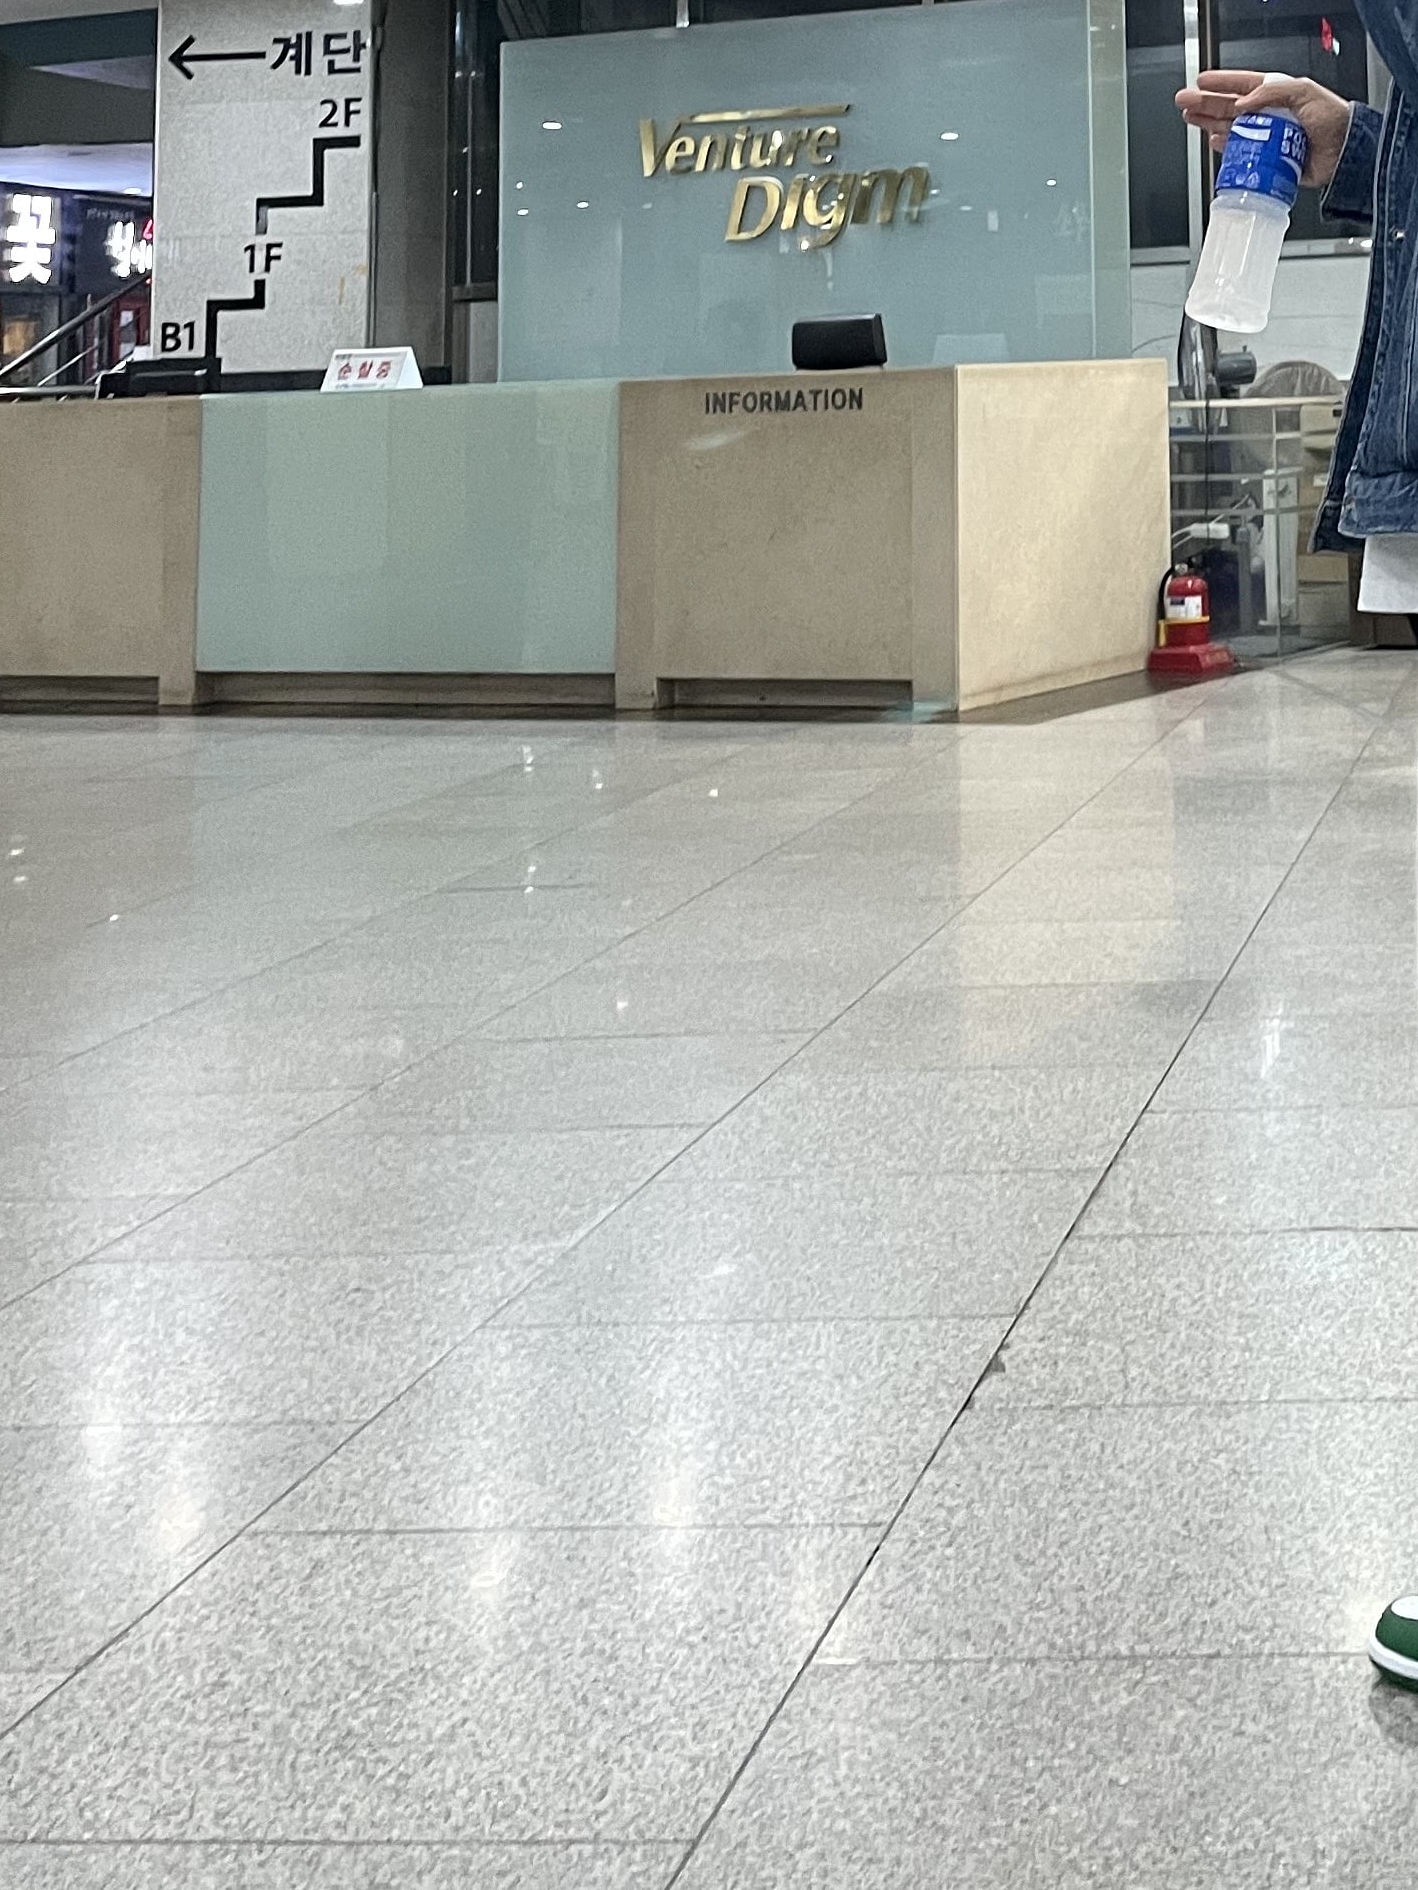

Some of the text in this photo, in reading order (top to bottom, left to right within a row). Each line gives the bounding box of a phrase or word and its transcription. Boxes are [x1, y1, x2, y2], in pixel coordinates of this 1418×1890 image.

[271, 30, 367, 76] 계단
[319, 98, 362, 128] 2F
[639, 106, 850, 177] Venture
[724, 166, 931, 251] Digm
[7, 193, 56, 284] 꽃
[244, 242, 283, 274] 1F
[161, 321, 195, 352] B1
[705, 388, 863, 414] INFORMATION
